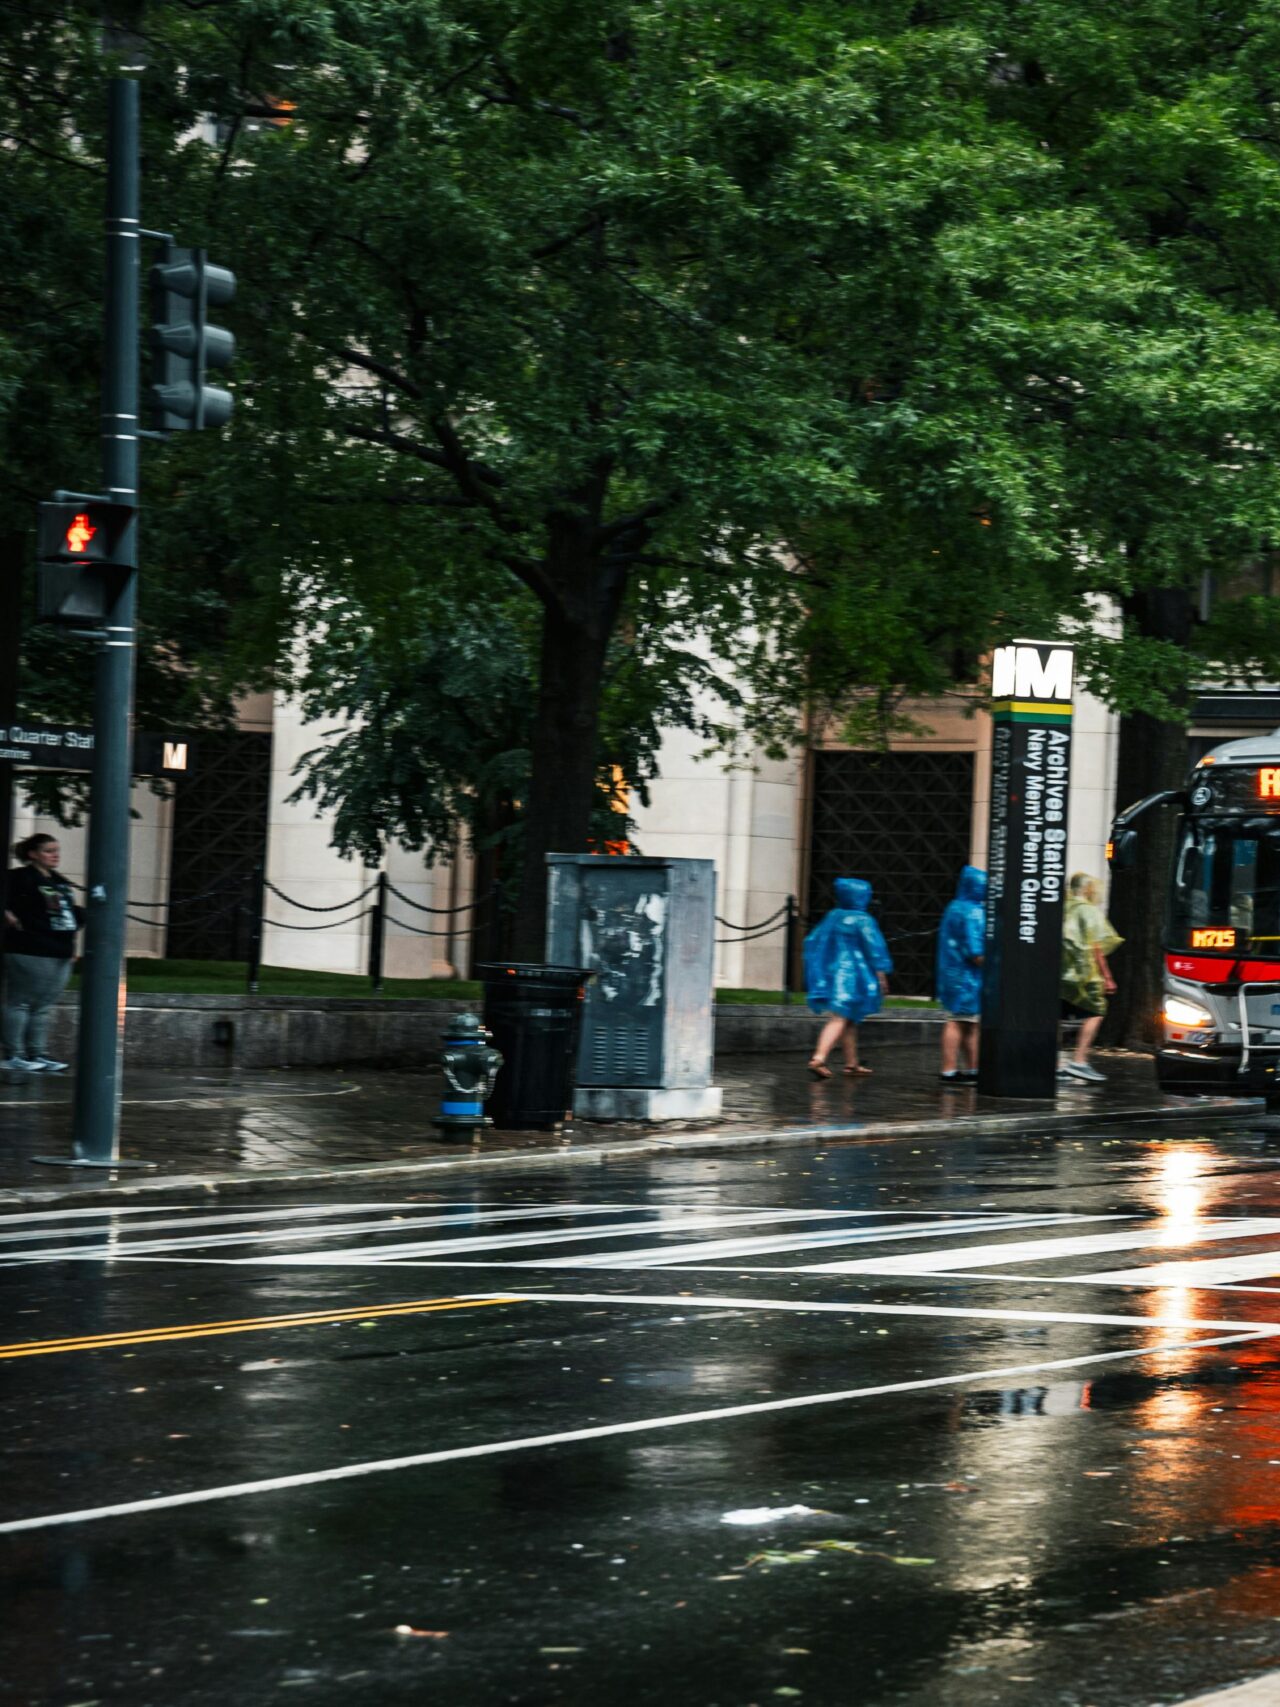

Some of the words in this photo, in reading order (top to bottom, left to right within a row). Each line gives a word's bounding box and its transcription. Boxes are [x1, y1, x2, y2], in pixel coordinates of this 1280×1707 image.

[1015, 647, 1073, 699] M
[163, 742, 187, 770] M
[1023, 729, 1046, 771] Navy
[1045, 729, 1070, 822] Archives
[1022, 775, 1045, 874] Mem'l-Penn
[1041, 828, 1066, 903] Station
[1019, 878, 1041, 944] Quarter
